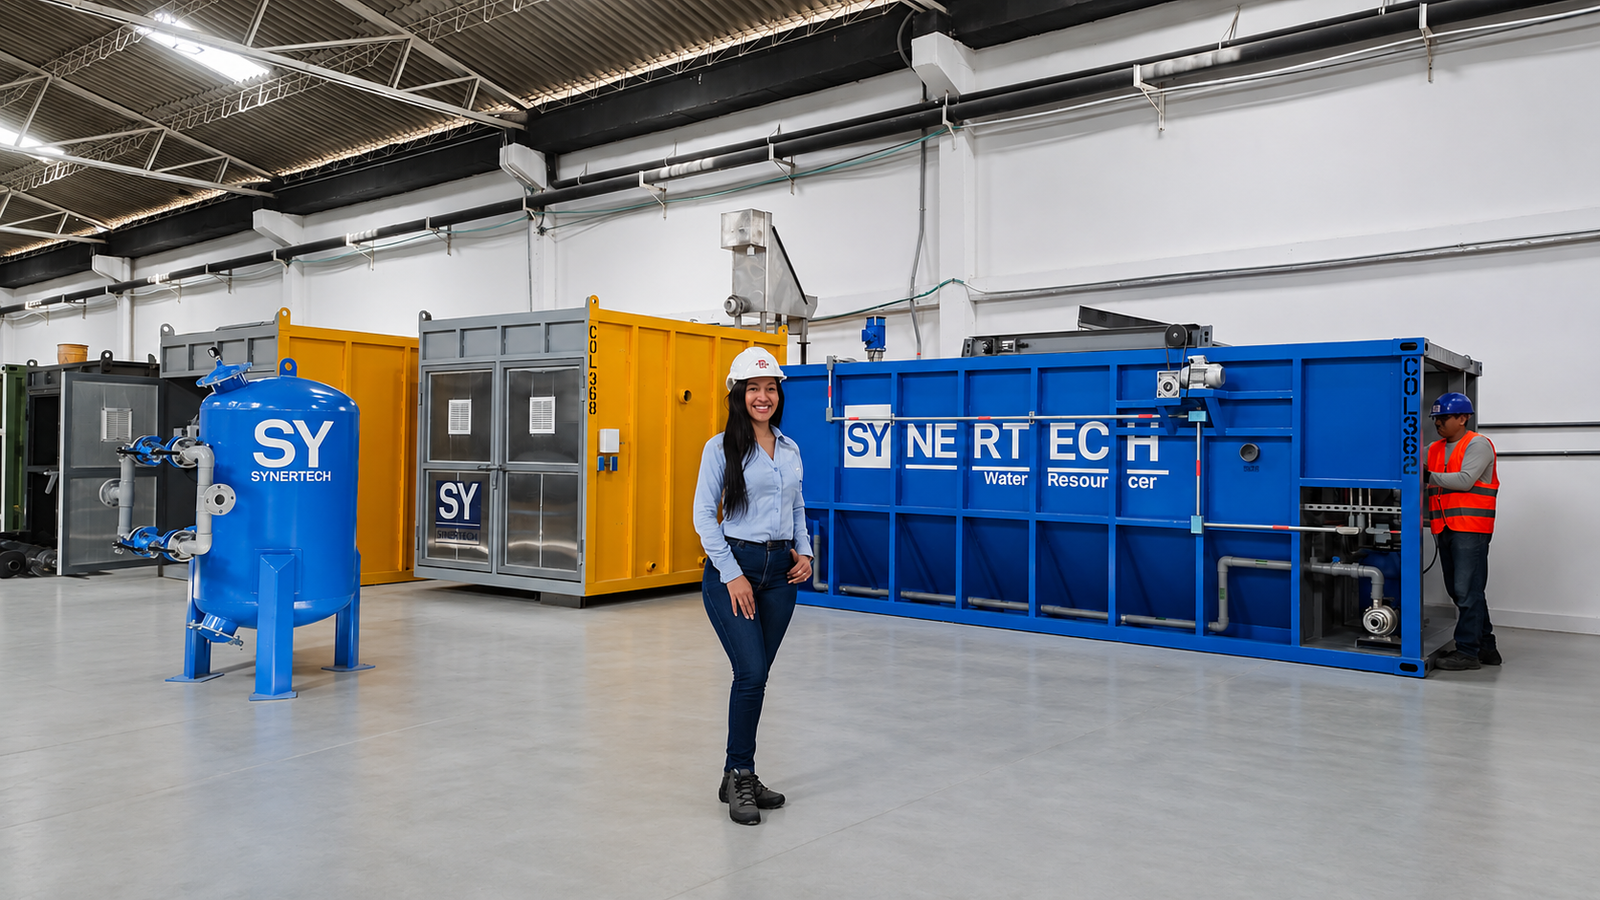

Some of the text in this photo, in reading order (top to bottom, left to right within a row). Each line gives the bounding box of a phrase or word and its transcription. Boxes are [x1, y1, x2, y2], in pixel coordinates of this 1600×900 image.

[252, 418, 335, 468] SY
[250, 470, 332, 482] SYNERTECH
[983, 471, 1028, 486] Water
[438, 481, 479, 520] SY
